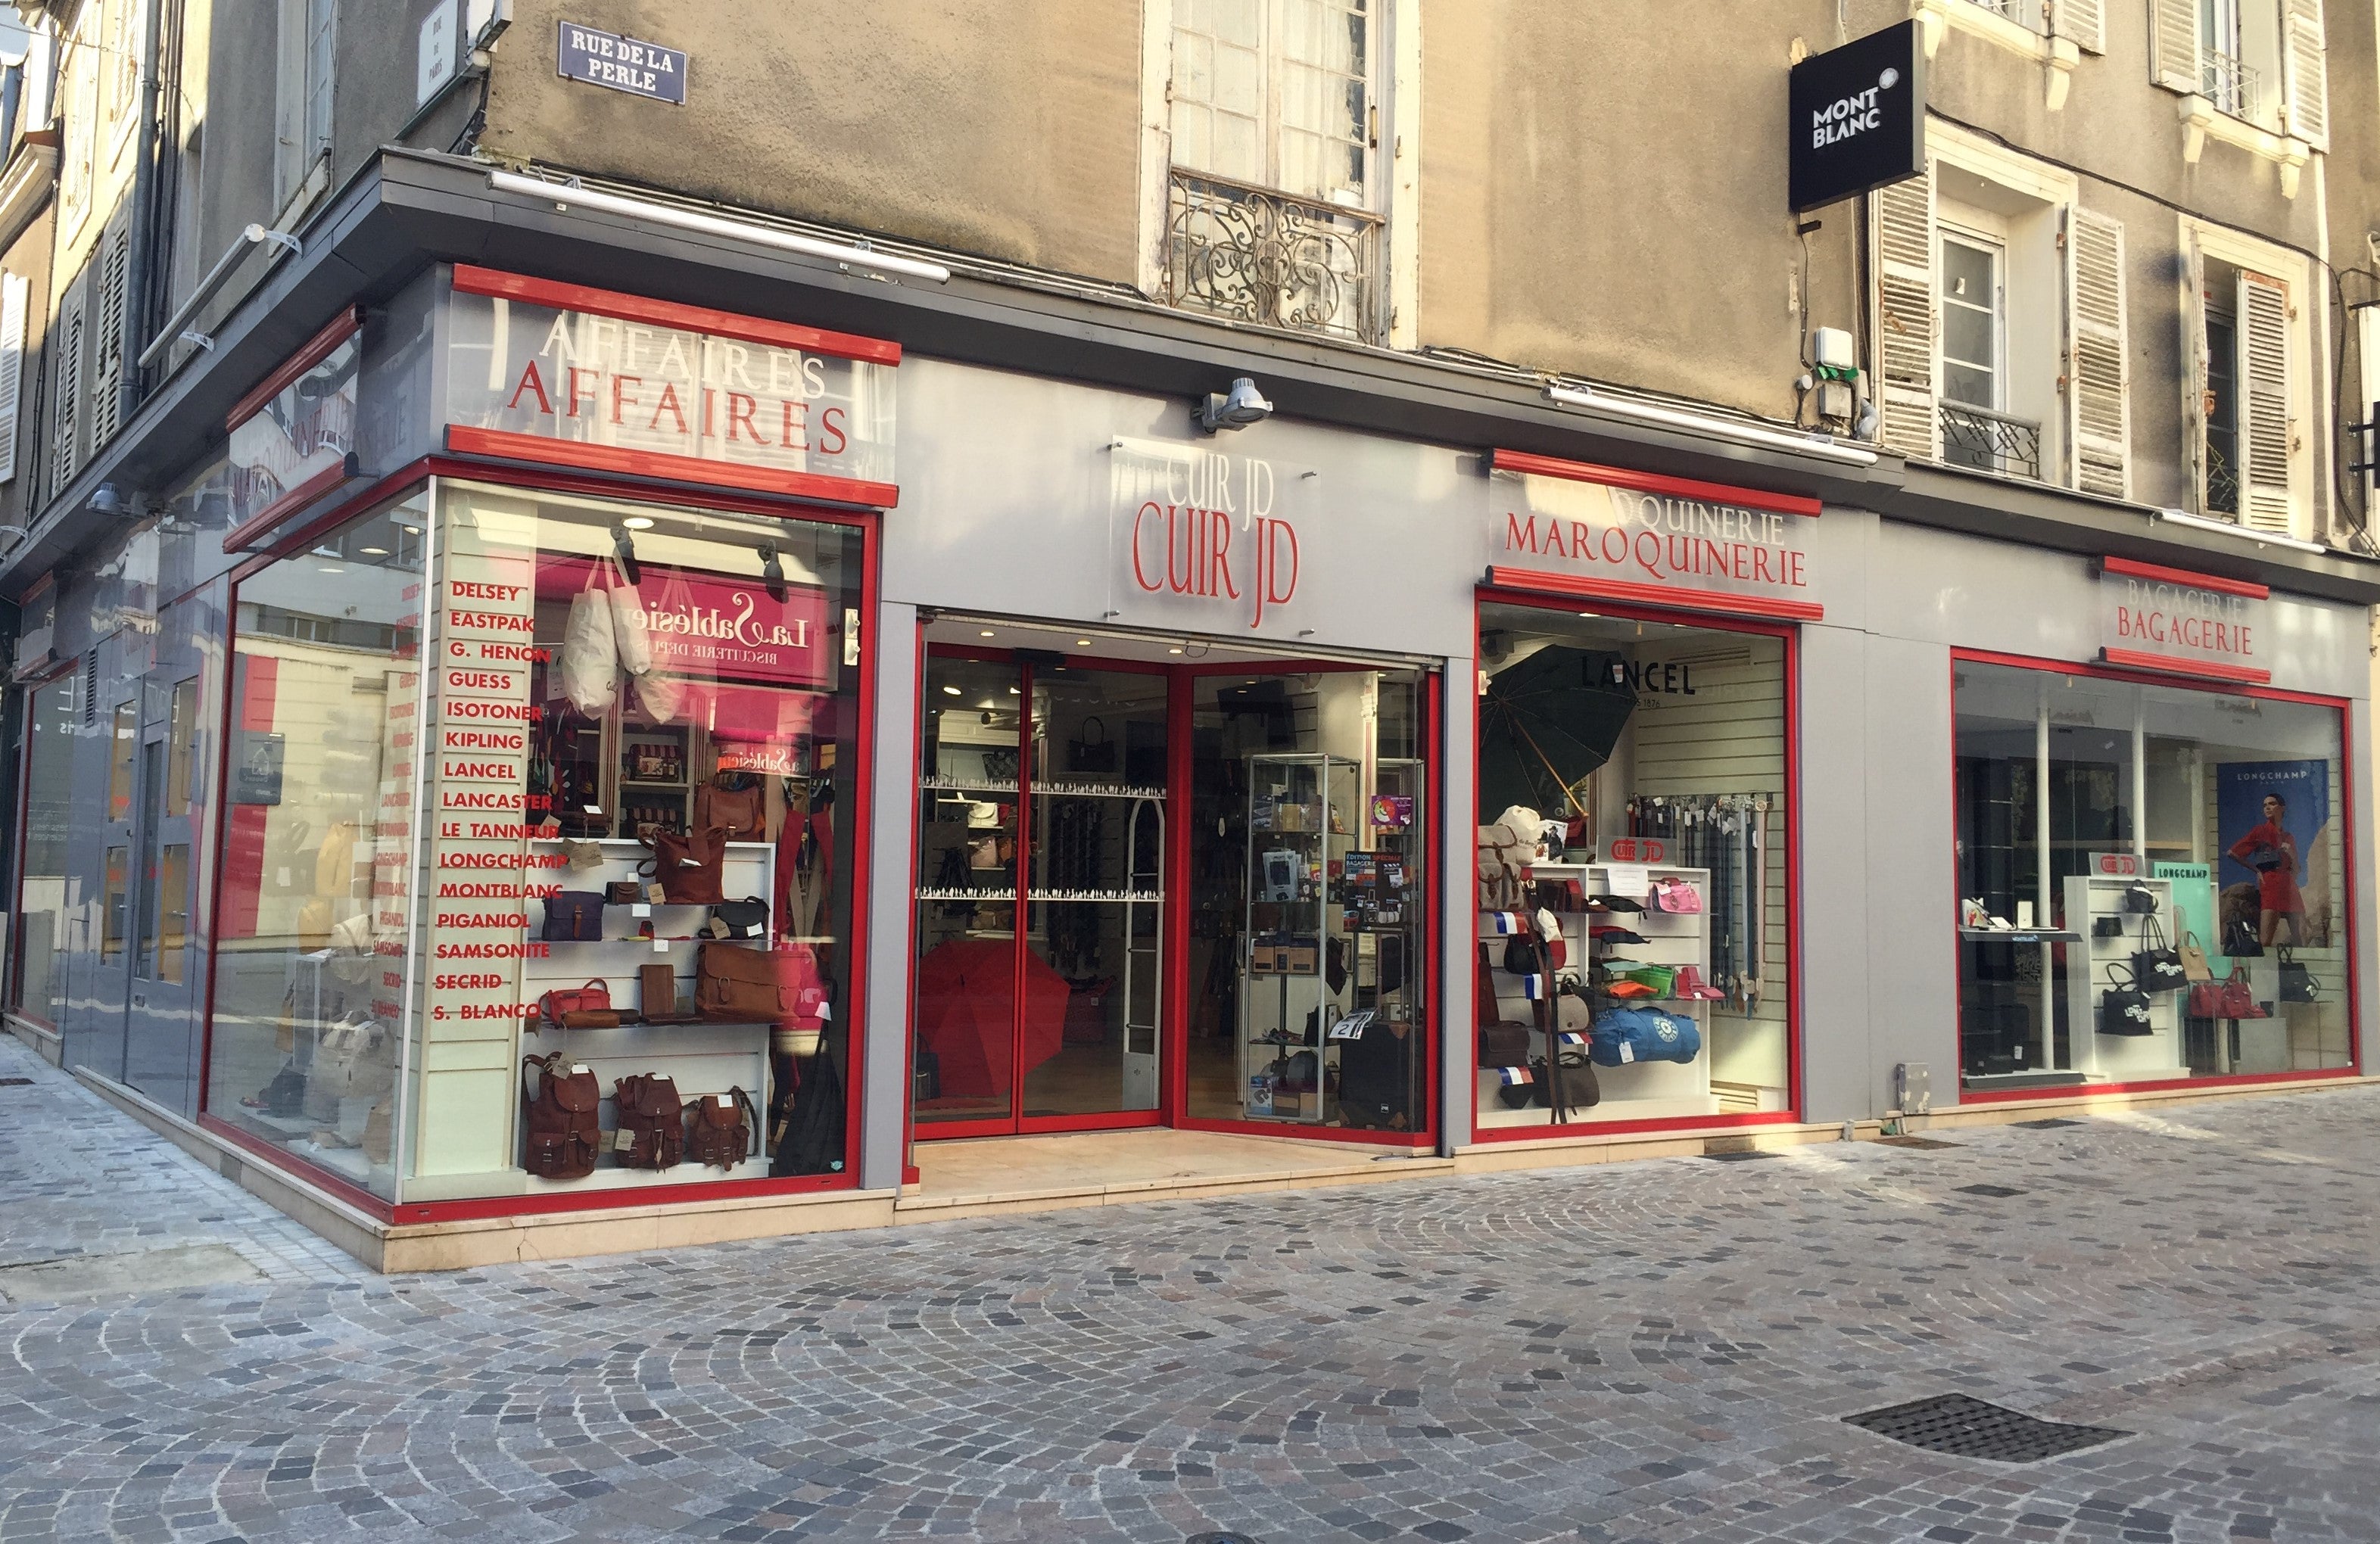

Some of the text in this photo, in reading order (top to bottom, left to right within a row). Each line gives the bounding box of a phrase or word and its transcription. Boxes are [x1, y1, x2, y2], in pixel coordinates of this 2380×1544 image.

[572, 30, 674, 73] RUE DE LA
[588, 58, 656, 92] PERLE
[1813, 86, 1879, 128] MONT
[1813, 108, 1880, 149] BLANC
[539, 315, 825, 399] AFFAIRES
[507, 360, 847, 455] AFFAIRES
[1167, 452, 1275, 531] CUIR JD
[1506, 512, 1807, 587] MAROQUINERIE
[1132, 501, 1299, 629] CUIR JD
[452, 581, 519, 602] DELSEY
[450, 612, 534, 633] EASTPAK
[2118, 606, 2253, 655] BAGAGERIE
[450, 642, 552, 663] G. HENON
[448, 671, 511, 690] GUESS
[1581, 655, 1696, 696] LANCEL
[447, 702, 543, 721] ISOTONER
[445, 732, 523, 749] KIPLING
[444, 761, 516, 779] LANCEL
[2237, 770, 2307, 780] LONGCHAMP
[443, 792, 553, 810] LANCASTER
[441, 822, 560, 839] LE TANNEUR
[440, 852, 569, 869] LONGCHAMP
[1610, 839, 1665, 862] CUIR JD
[2158, 868, 2207, 879] LONGCHAMP
[439, 883, 563, 898] MONTBLANC
[437, 914, 531, 929] PIGANIOL
[436, 943, 550, 959] SAMSONITE
[435, 974, 502, 989] SECRID
[433, 1003, 541, 1020] S. BLANCO
